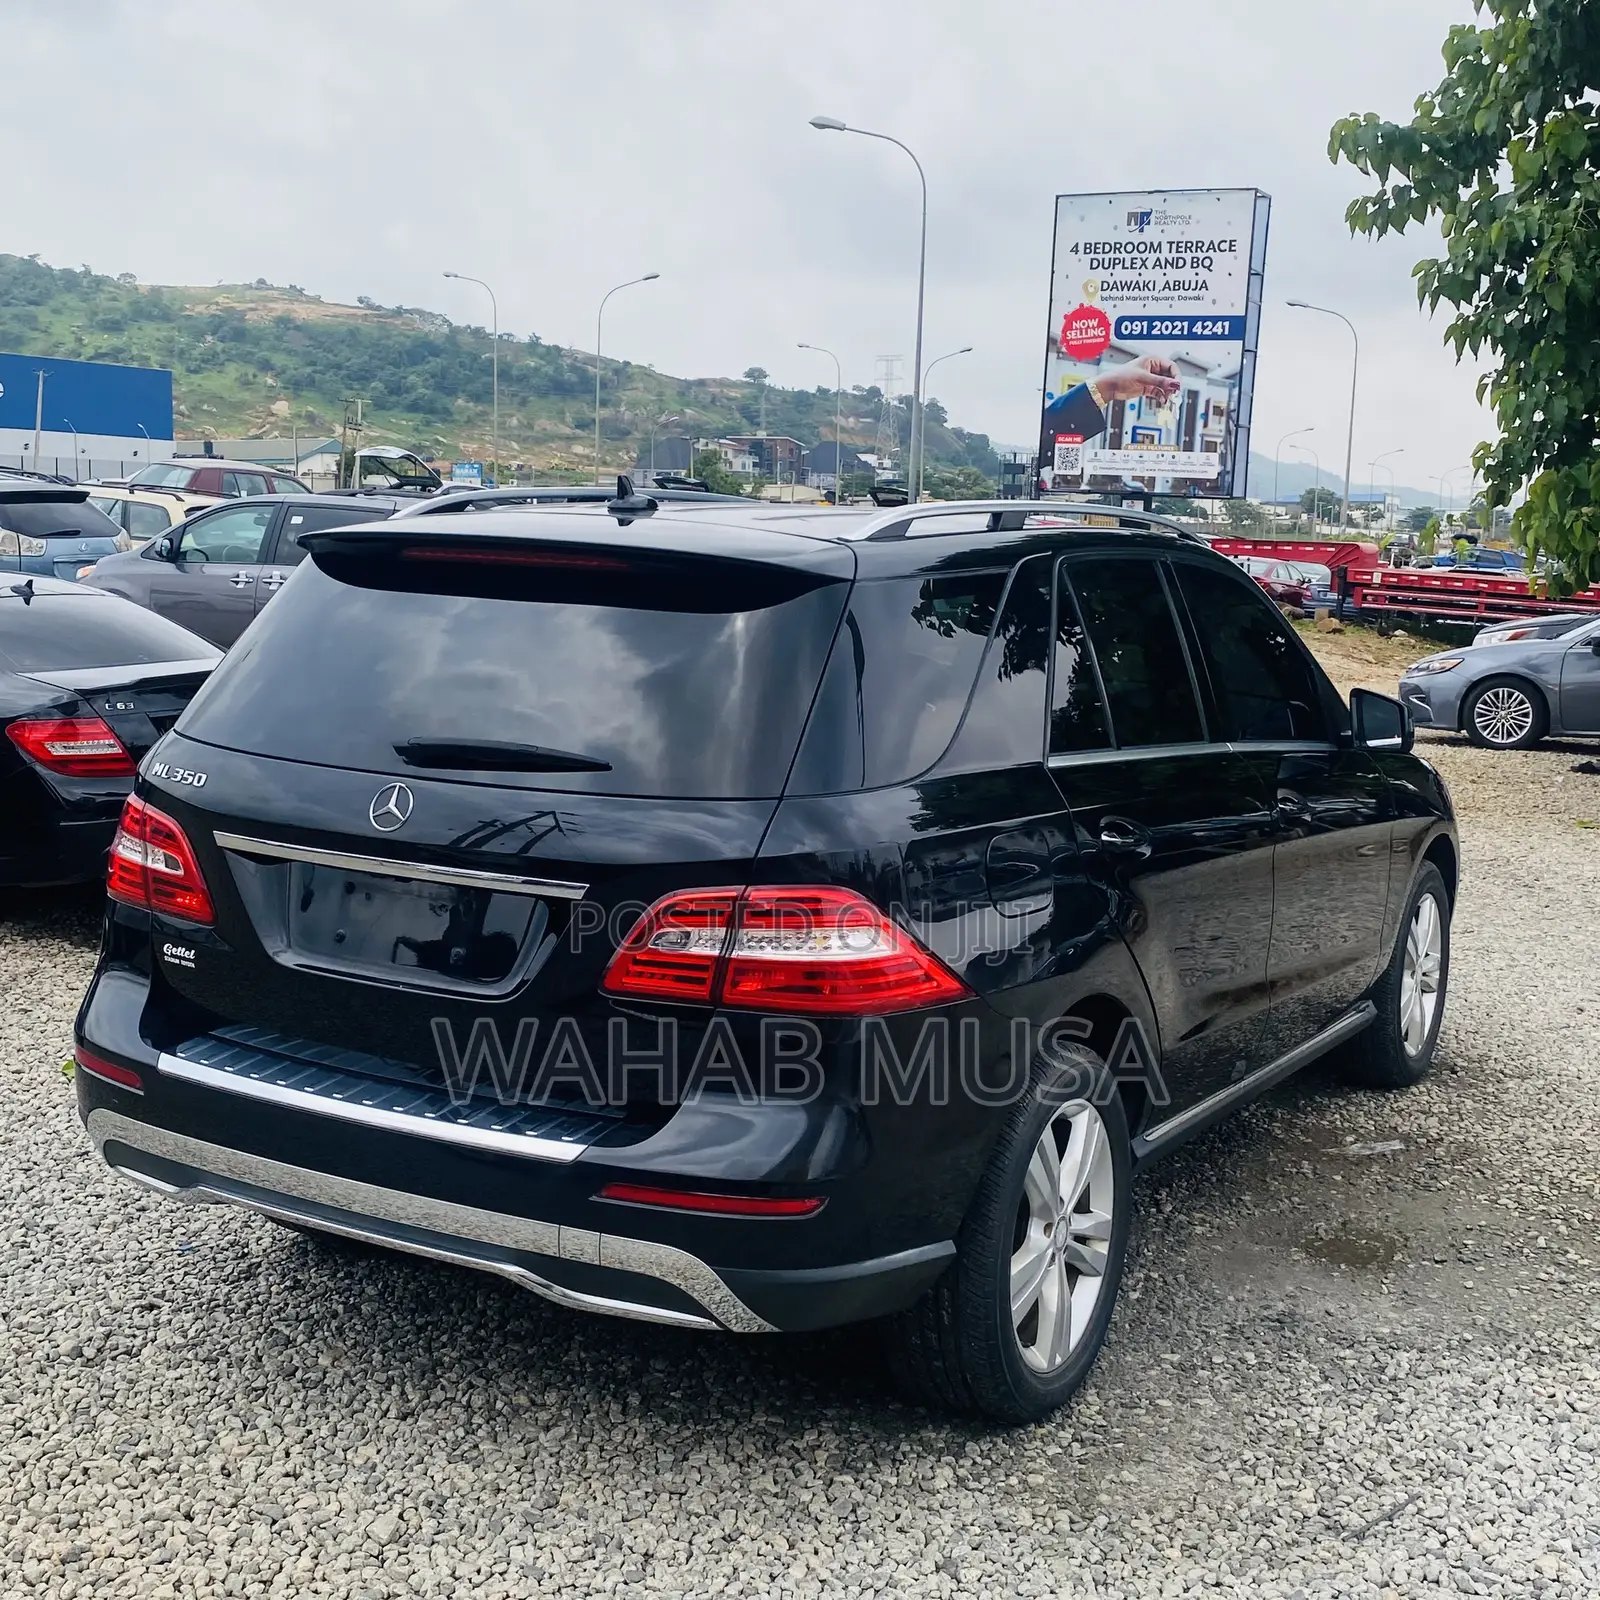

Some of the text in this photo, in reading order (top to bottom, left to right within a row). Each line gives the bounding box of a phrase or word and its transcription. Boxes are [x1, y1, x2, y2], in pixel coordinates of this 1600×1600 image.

[1069, 239, 1237, 255] 4 BEDROOM TERRACE
[1089, 256, 1213, 272] DUPLEX AND BQ
[1100, 280, 1156, 292] DAWAKI
[1072, 318, 1099, 330] NOW
[1120, 321, 1230, 335] 091 2021 4241
[1066, 327, 1106, 340] SELLING
[105, 702, 135, 711] C 63
